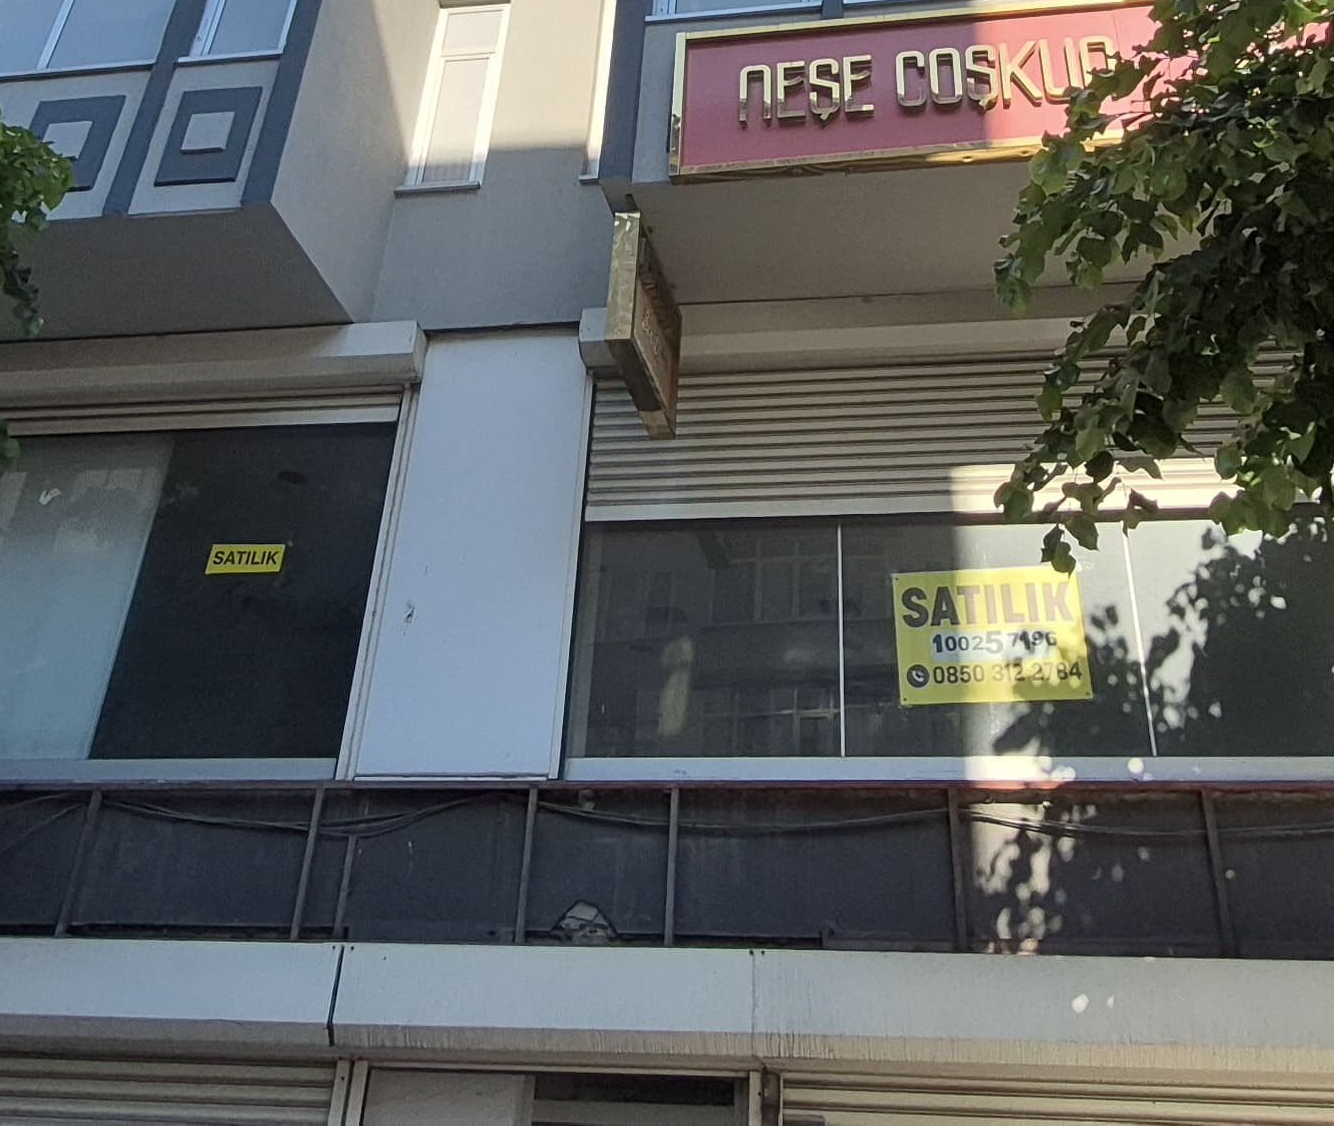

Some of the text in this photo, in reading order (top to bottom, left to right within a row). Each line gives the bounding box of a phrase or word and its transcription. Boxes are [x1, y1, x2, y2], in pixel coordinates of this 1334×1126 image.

[213, 550, 280, 565] SATILIK
[901, 581, 1075, 628] SATILIK
[933, 665, 986, 685] 0850
[991, 662, 1026, 683] 312
